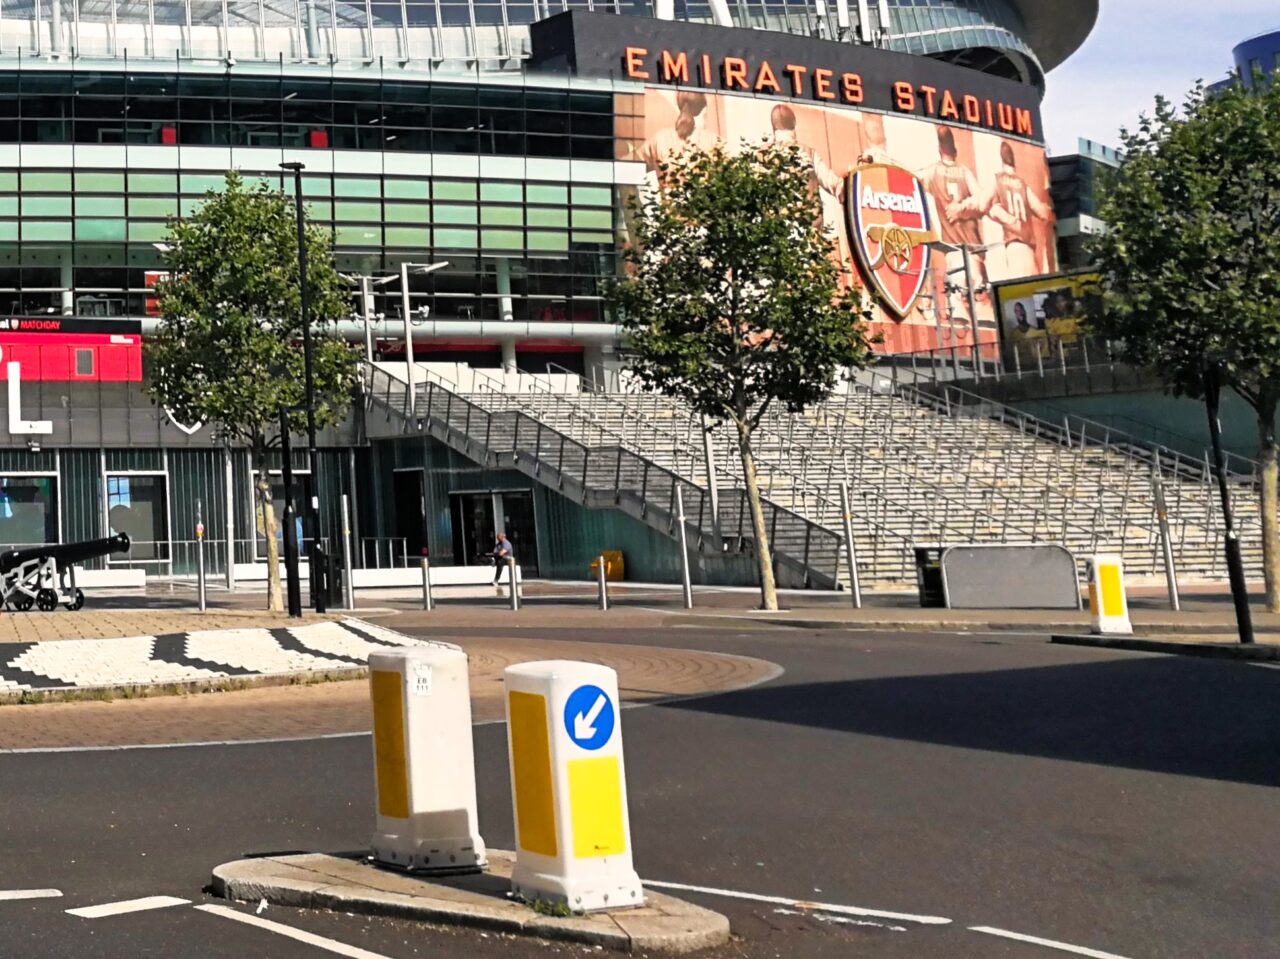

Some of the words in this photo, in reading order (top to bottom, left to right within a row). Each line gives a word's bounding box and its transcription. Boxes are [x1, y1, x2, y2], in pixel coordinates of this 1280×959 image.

[625, 46, 864, 103] EMIRATES
[893, 80, 1032, 136] STADIUM
[861, 184, 921, 214] Arsenal
[20, 320, 61, 330] MATCHDAY
